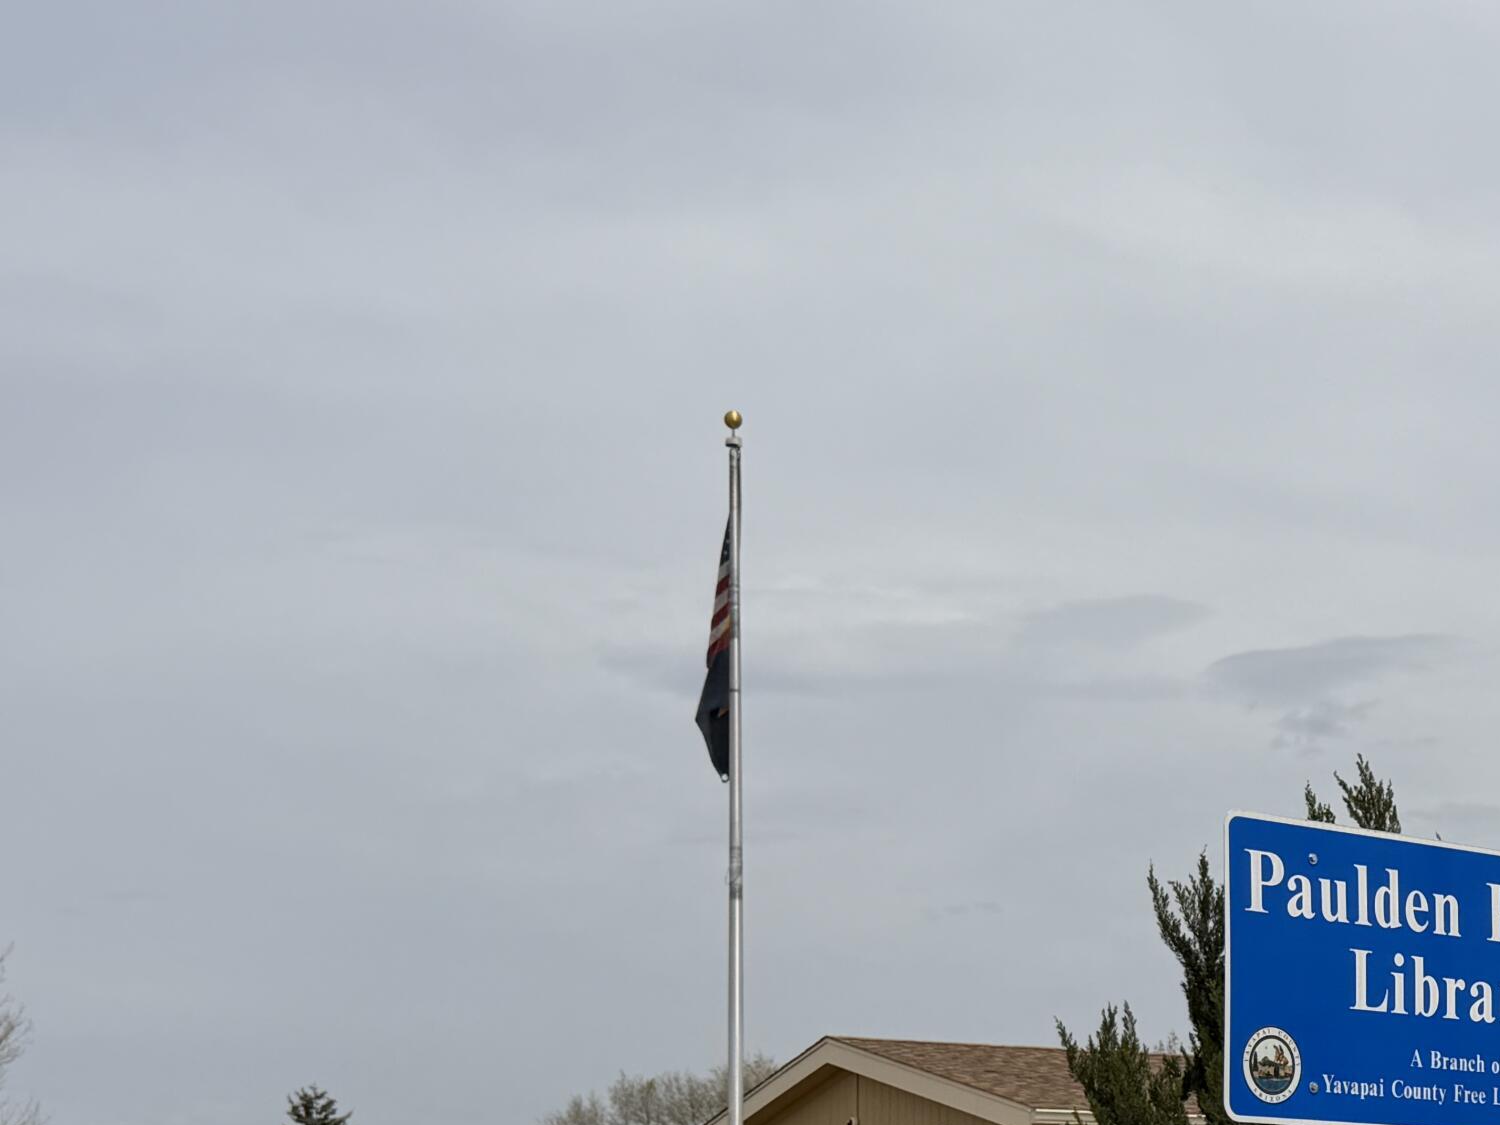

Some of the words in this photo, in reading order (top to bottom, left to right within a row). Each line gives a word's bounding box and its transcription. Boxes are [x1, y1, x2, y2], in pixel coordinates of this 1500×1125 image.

[1244, 848, 1462, 938] Paulden
[1410, 1049, 1423, 1068] A
[1430, 1050, 1485, 1073] Branch
[1322, 1074, 1384, 1100] Yavapai
[1391, 1079, 1447, 1105] County
[1454, 1084, 1486, 1104] Free
